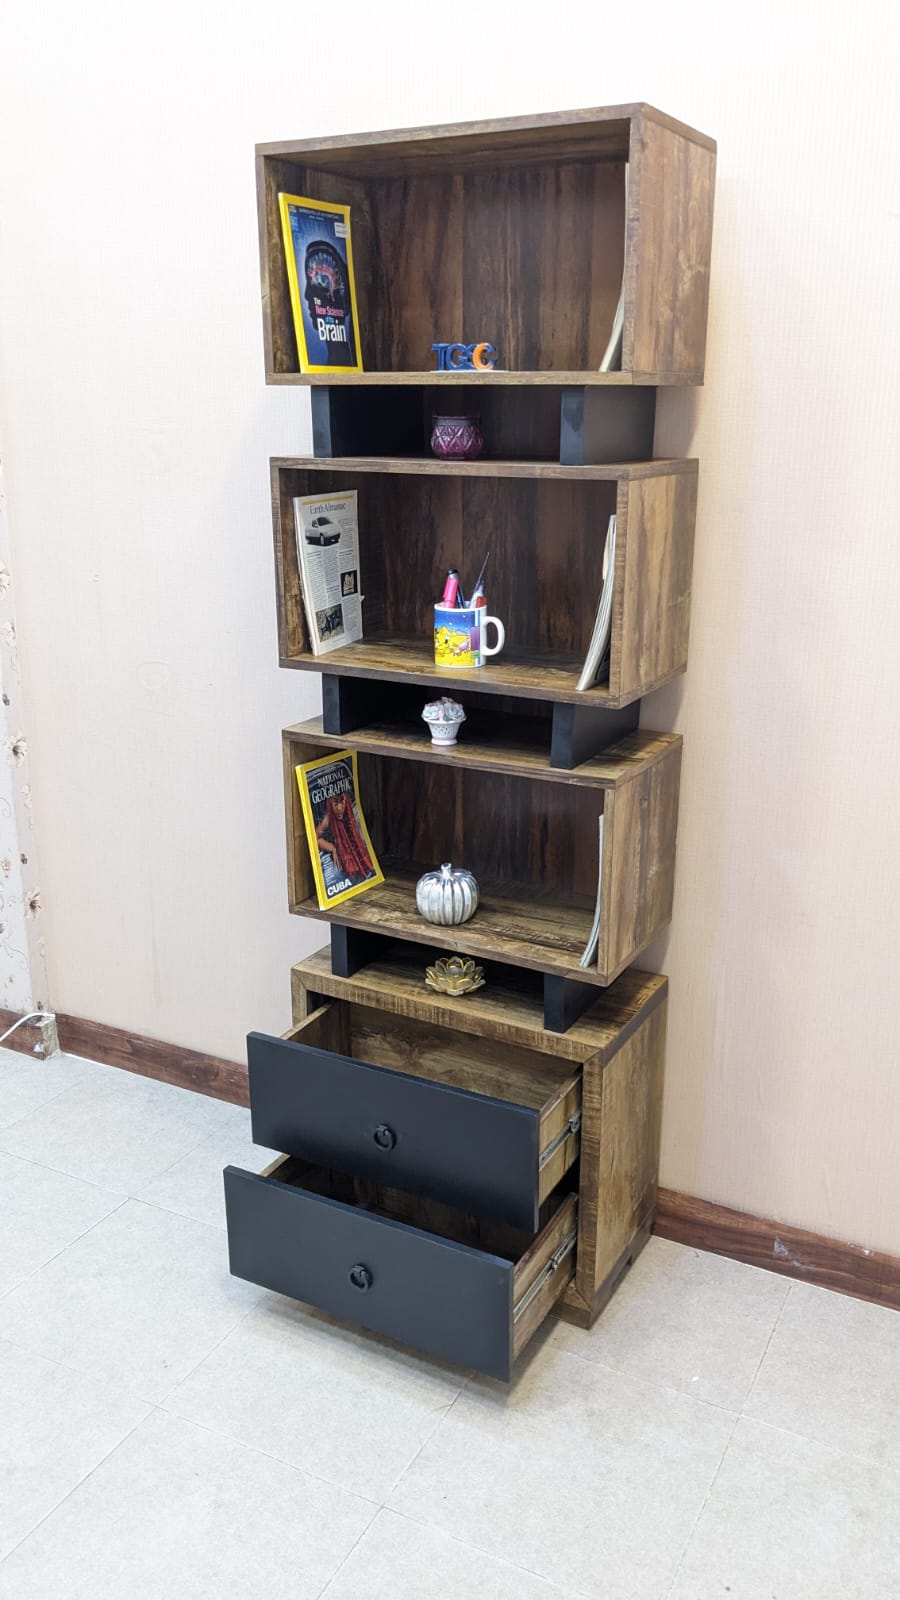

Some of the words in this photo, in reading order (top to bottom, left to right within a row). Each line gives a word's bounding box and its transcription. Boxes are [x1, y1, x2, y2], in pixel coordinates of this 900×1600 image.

[315, 305, 326, 315] New
[326, 305, 345, 317] Science
[317, 318, 346, 342] Brain
[317, 769, 345, 787] NATIONAL
[311, 776, 353, 804] GEOGRAPHIC
[327, 878, 353, 896] CUBA
